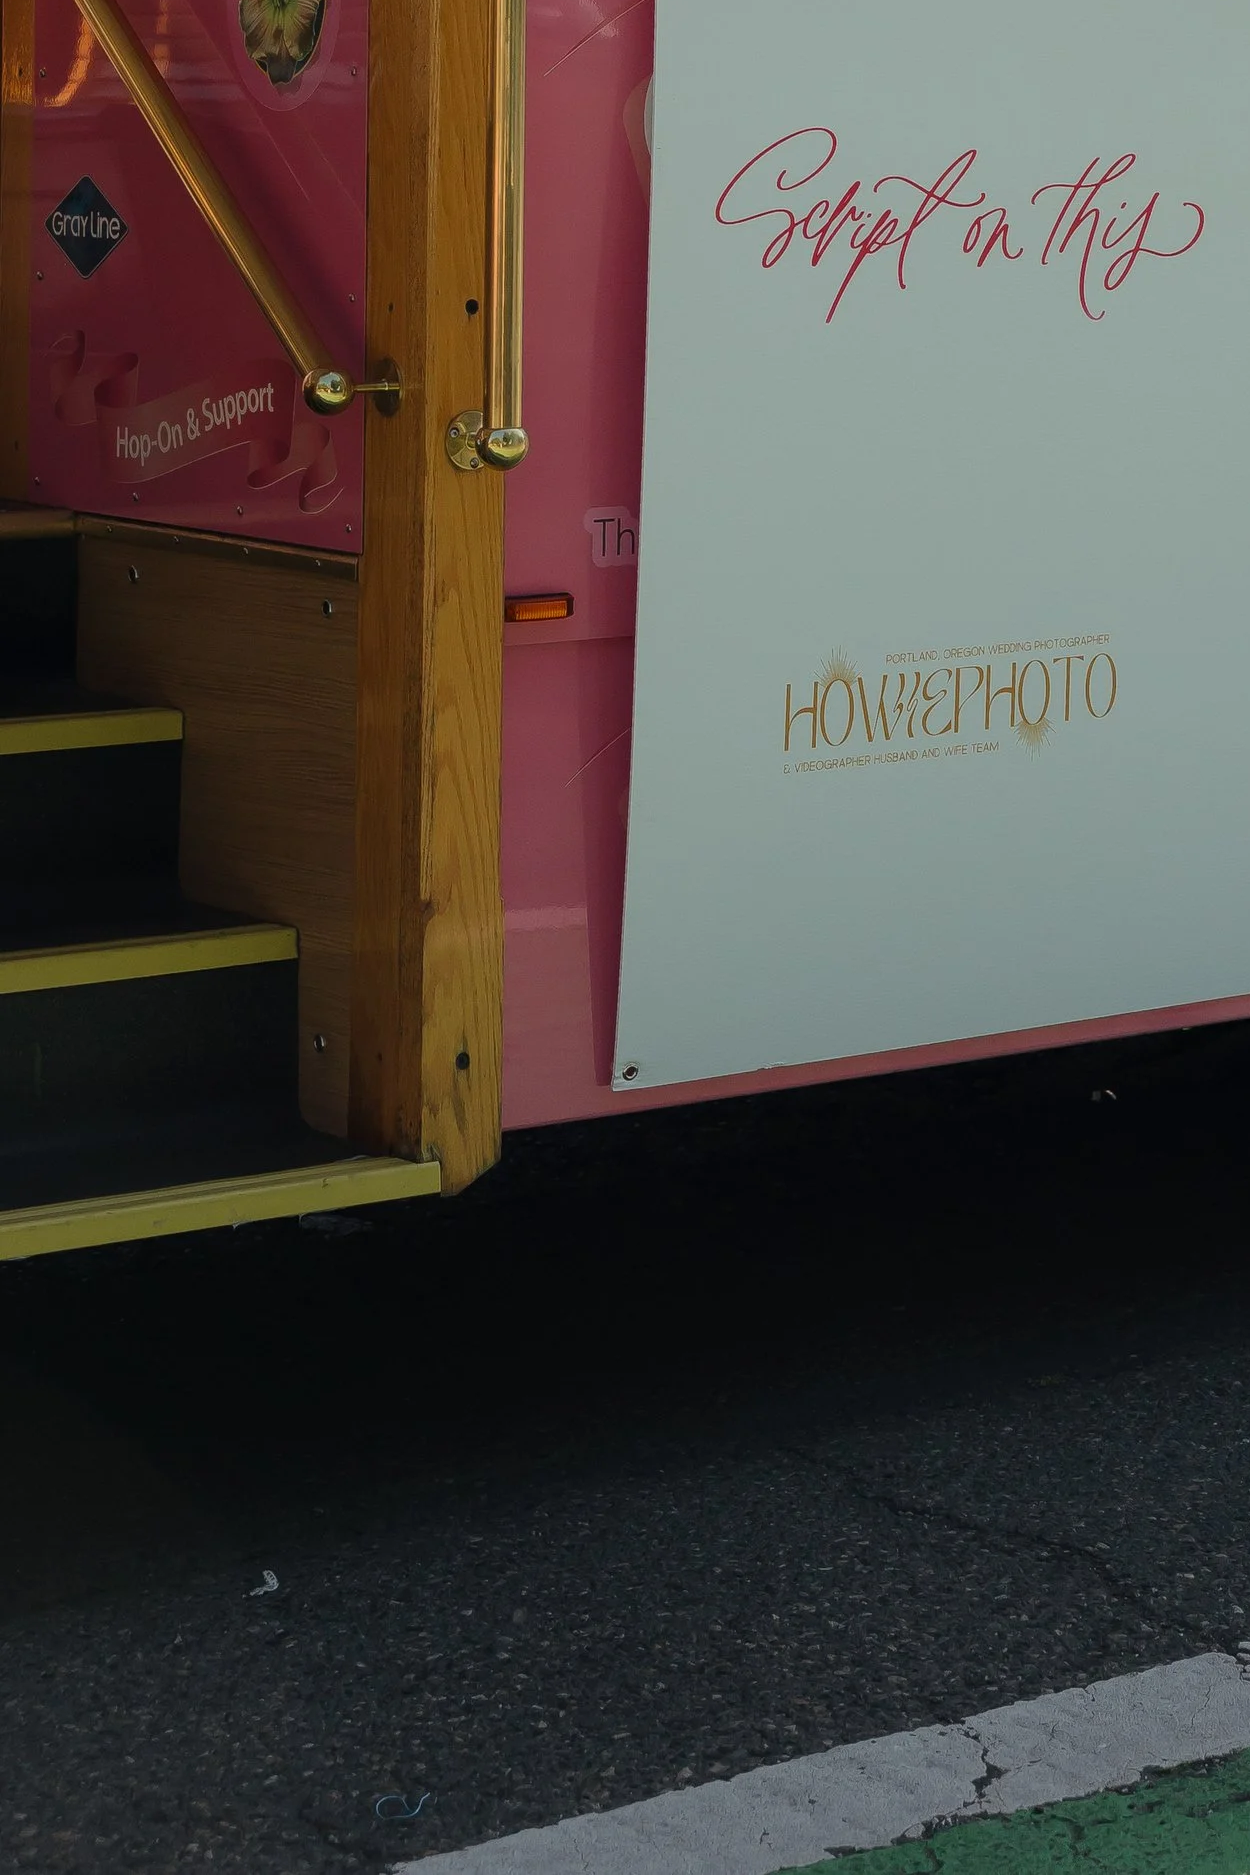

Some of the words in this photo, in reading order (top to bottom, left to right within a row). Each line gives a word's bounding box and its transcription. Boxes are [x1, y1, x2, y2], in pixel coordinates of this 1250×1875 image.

[715, 127, 986, 324] Script
[962, 206, 1024, 268] on
[116, 421, 183, 467] Hop-On
[186, 407, 201, 441] &
[202, 382, 274, 431] Support
[885, 649, 941, 665] PORTLAND,
[943, 645, 985, 660] OREGON
[988, 640, 1032, 656] WEDDING
[1034, 633, 1111, 651] PHOTOGRAPHER
[794, 754, 871, 773] VIDEOGRAPHER
[873, 750, 919, 766] HUSBAND
[921, 747, 941, 760] AND
[944, 744, 968, 756] WIFE
[971, 741, 1000, 754] TEAM
